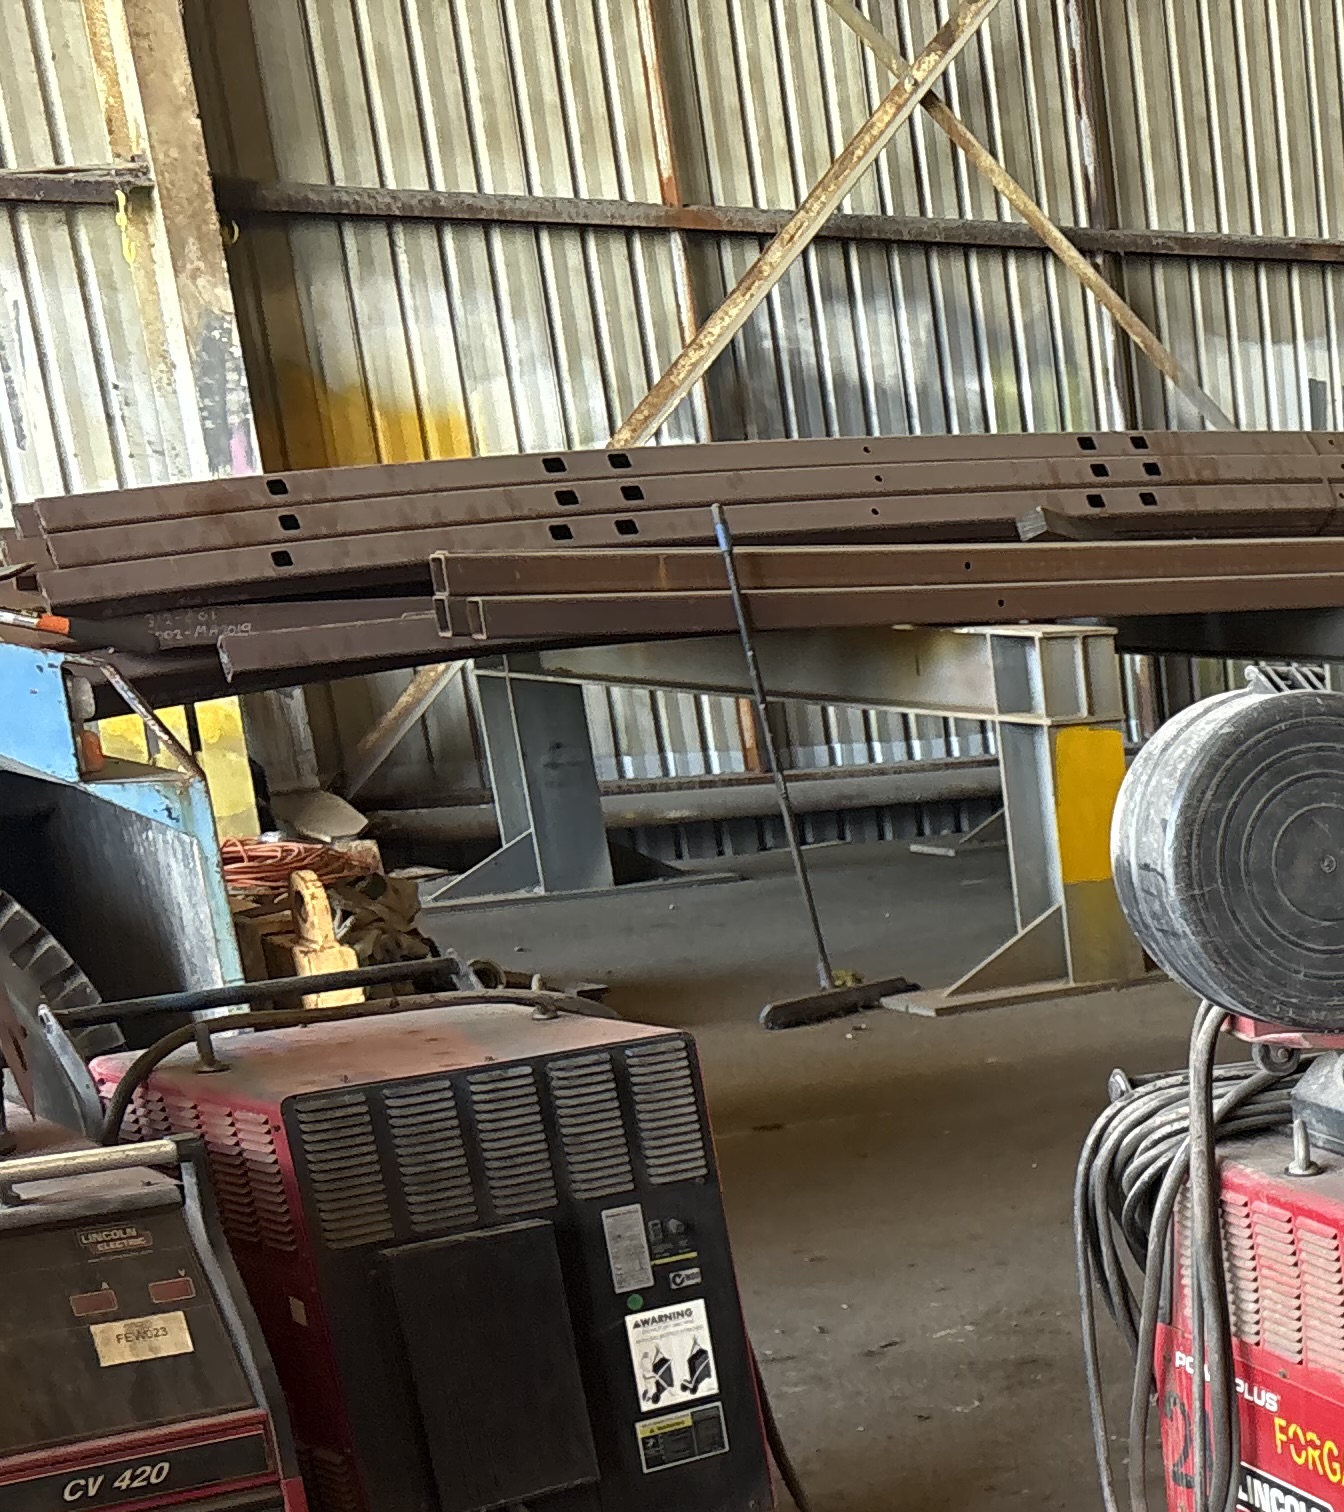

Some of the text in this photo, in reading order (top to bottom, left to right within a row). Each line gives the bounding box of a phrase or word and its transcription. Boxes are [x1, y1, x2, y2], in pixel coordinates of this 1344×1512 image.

[81, 1227, 137, 1245] LINCOLN
[640, 1307, 693, 1328] WARNING
[63, 1461, 171, 1502] CV 420
